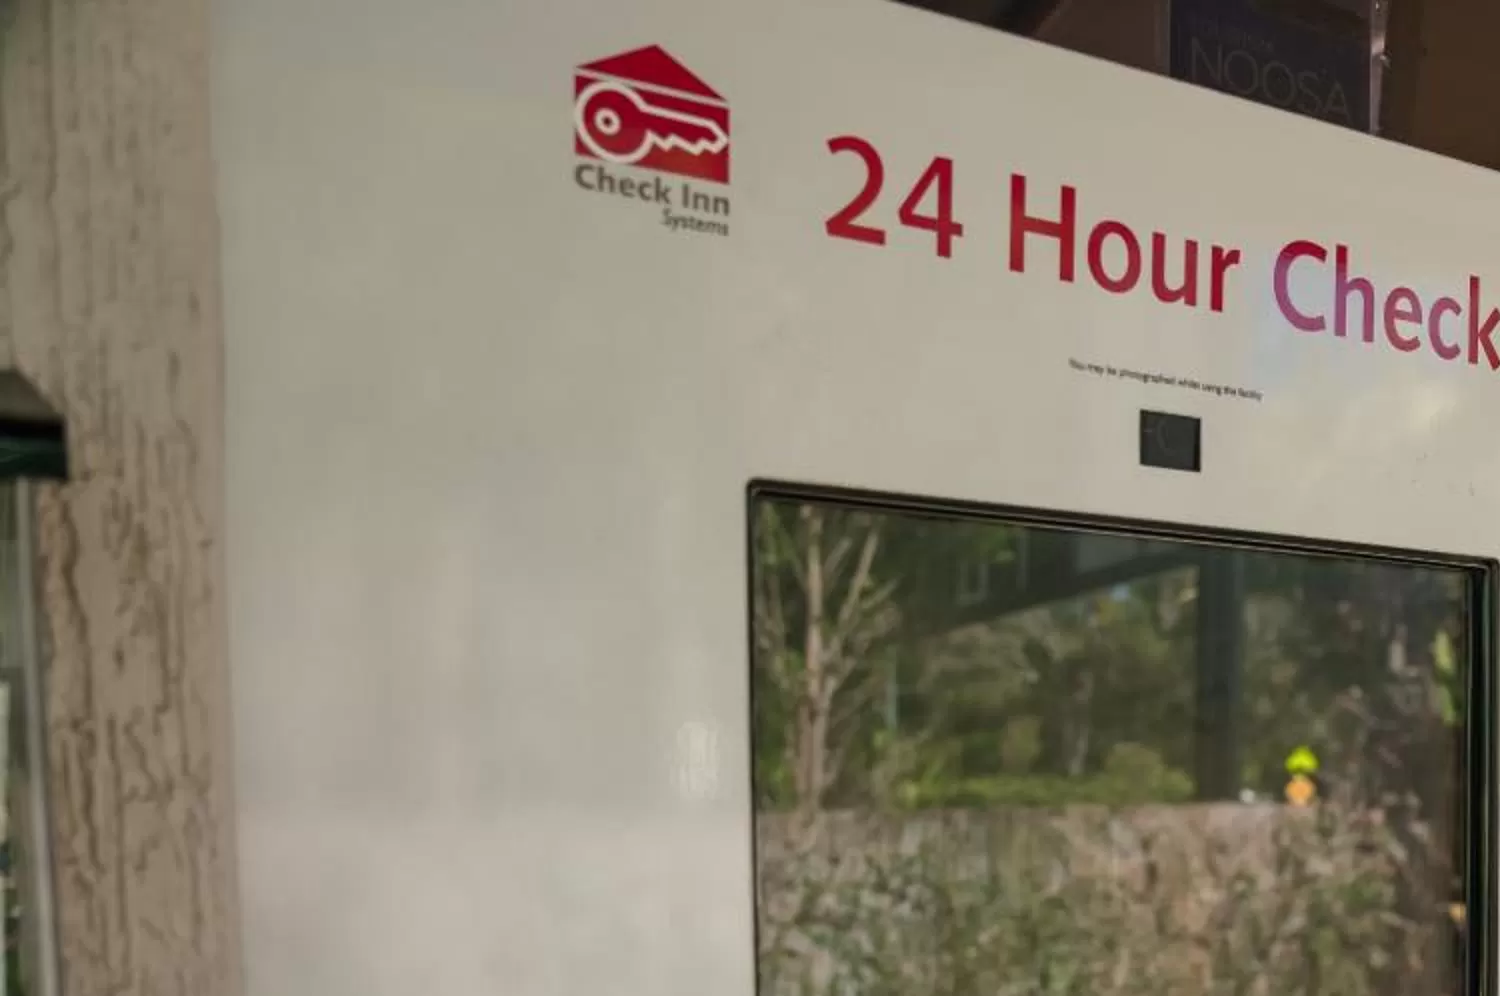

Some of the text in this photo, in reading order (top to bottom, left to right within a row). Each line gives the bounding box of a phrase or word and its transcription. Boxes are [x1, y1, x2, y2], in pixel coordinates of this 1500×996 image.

[1191, 36, 1352, 124] NOOSA
[575, 163, 730, 216] Check Inn
[662, 207, 730, 236] Systems
[825, 135, 963, 258] 24
[1009, 173, 1240, 313] Hour
